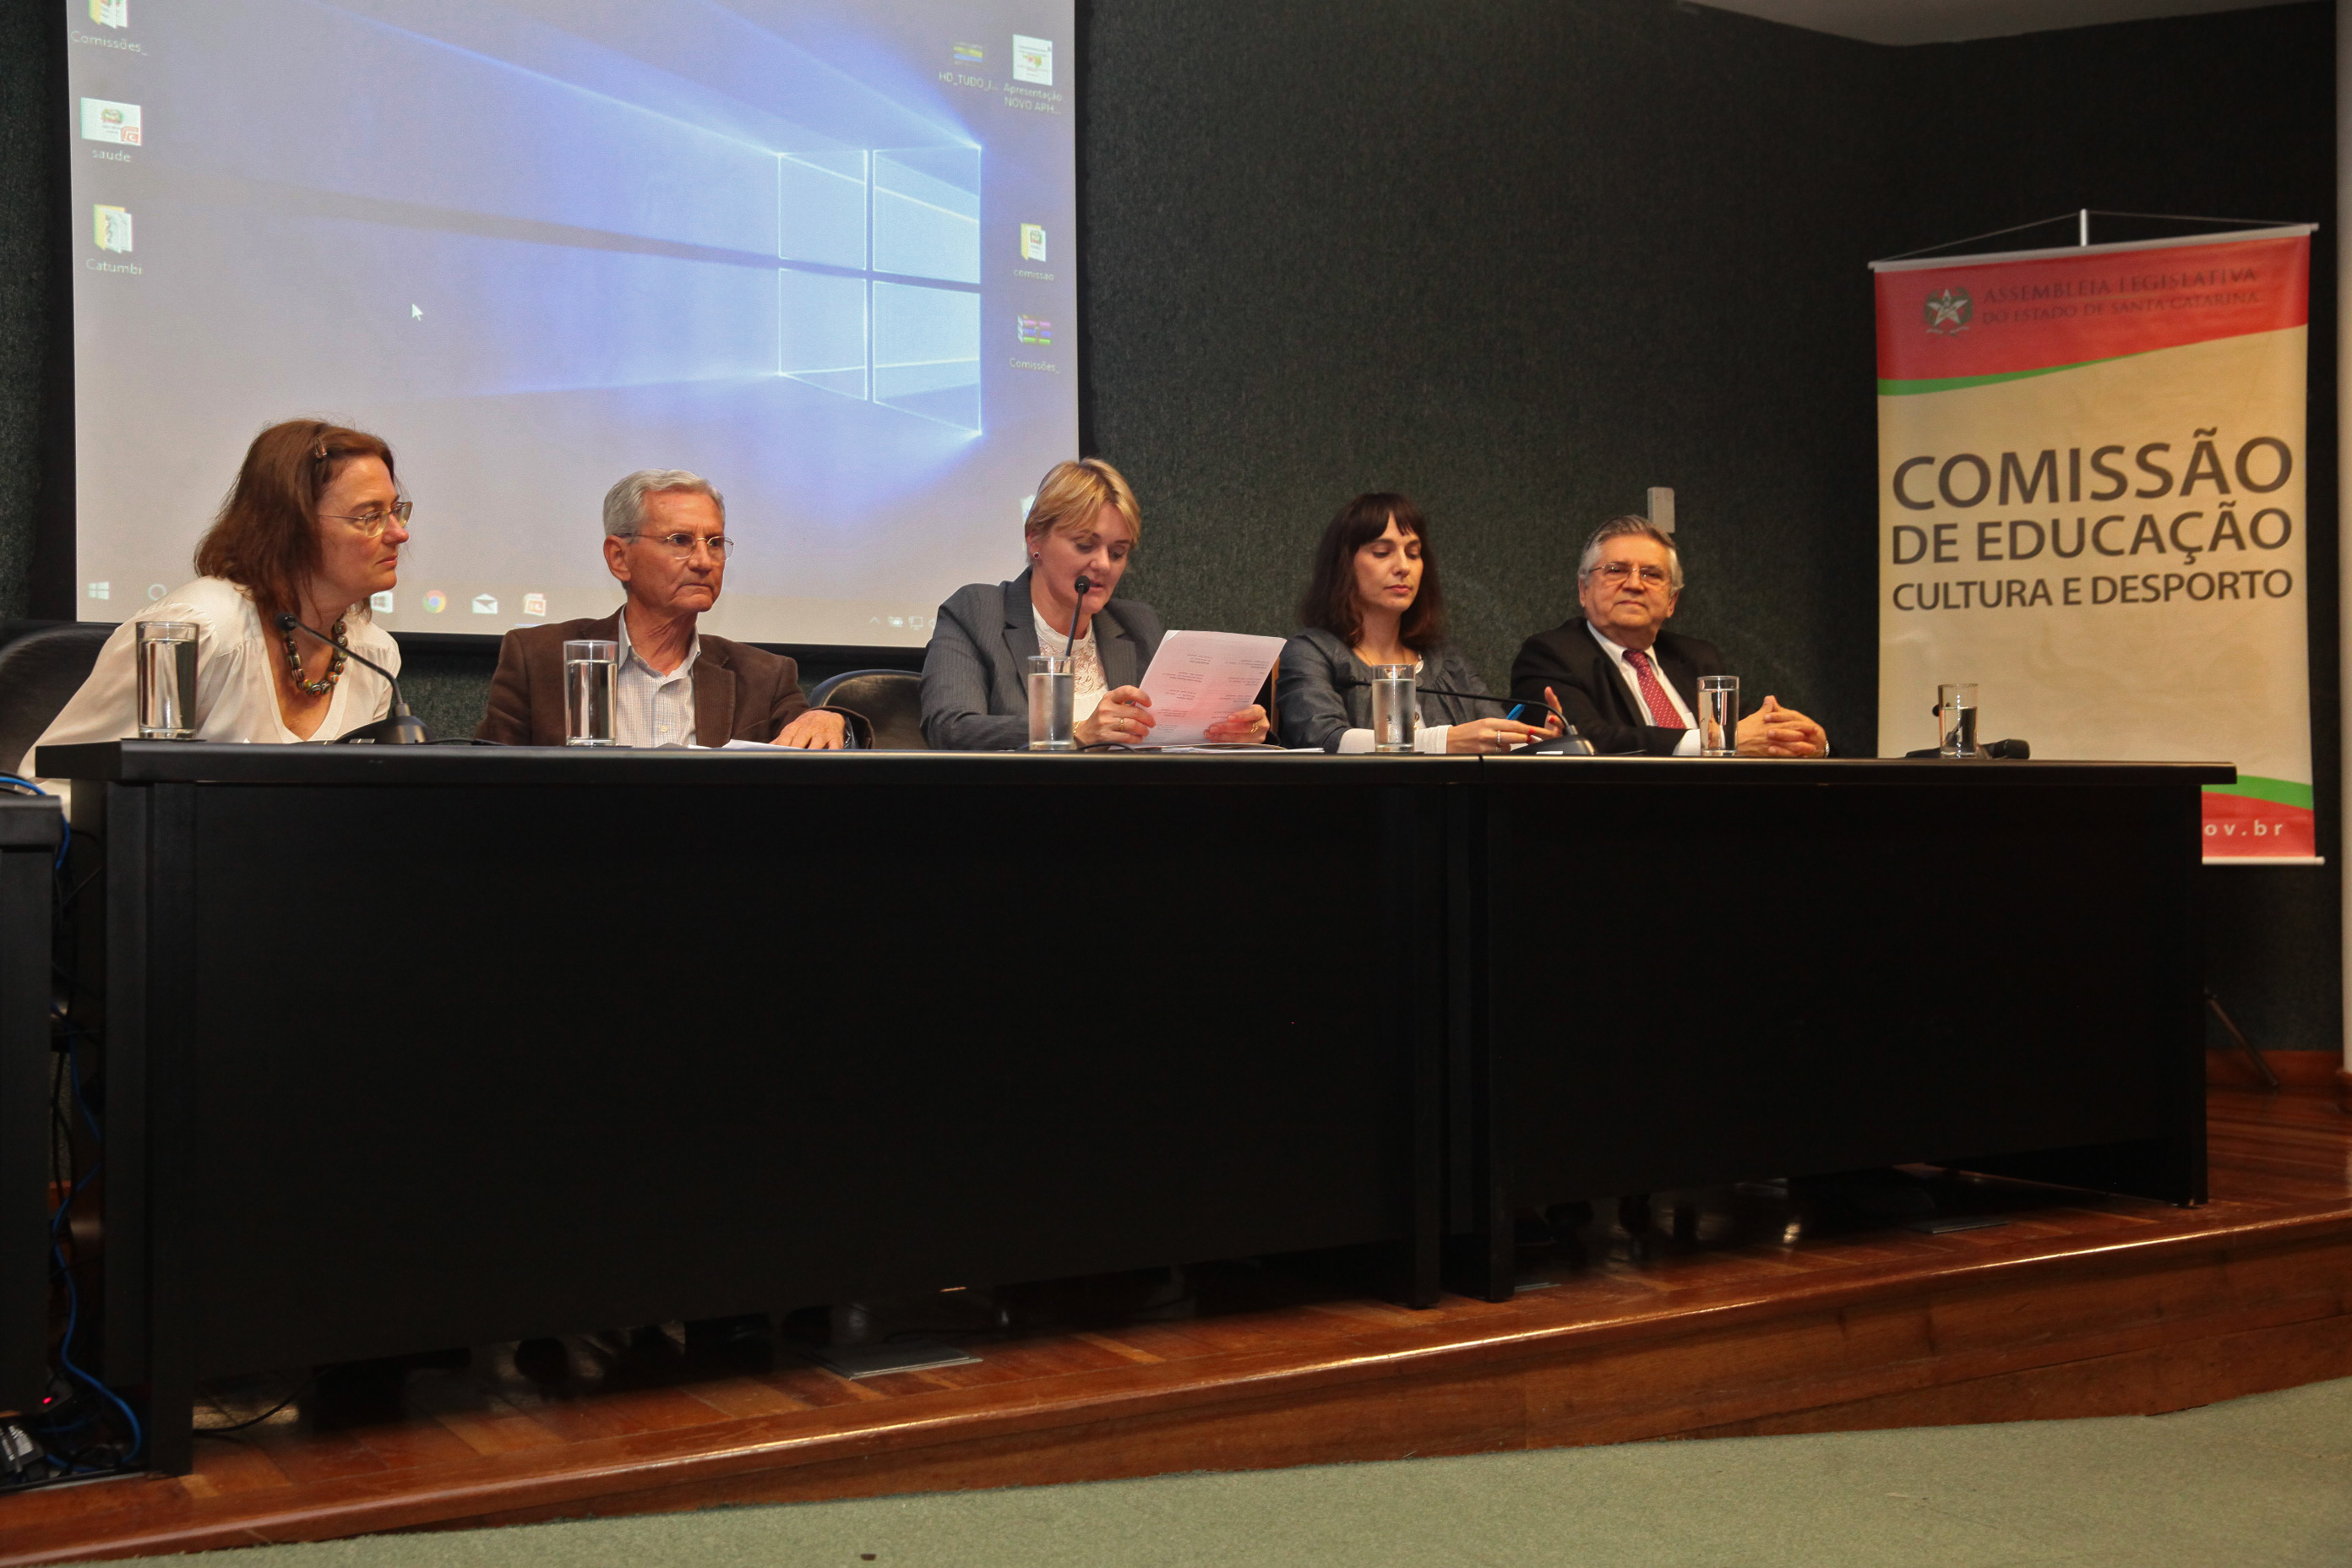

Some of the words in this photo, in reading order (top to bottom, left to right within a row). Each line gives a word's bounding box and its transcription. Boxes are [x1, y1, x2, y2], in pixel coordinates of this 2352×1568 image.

[1003, 83, 1063, 102] Apresentação
[1004, 96, 1032, 111] NOVO
[92, 149, 131, 162] saude
[1983, 280, 2110, 305] ASSEMBLEIA
[2119, 267, 2258, 295] LEGISLATIVA
[1983, 310, 2009, 326] DO
[2014, 305, 2077, 323] ESTADO
[2083, 303, 2104, 316] DE
[2113, 298, 2164, 314] SANTA
[2170, 291, 2259, 309] CATARINA
[1892, 426, 2293, 510] COMISSÃO
[1892, 522, 1959, 565] DE
[1977, 500, 2292, 565] EDUCAÇÃO
[1892, 577, 2053, 611] CULTURA
[2062, 577, 2082, 605] E
[2091, 569, 2293, 605] DESPORTO
